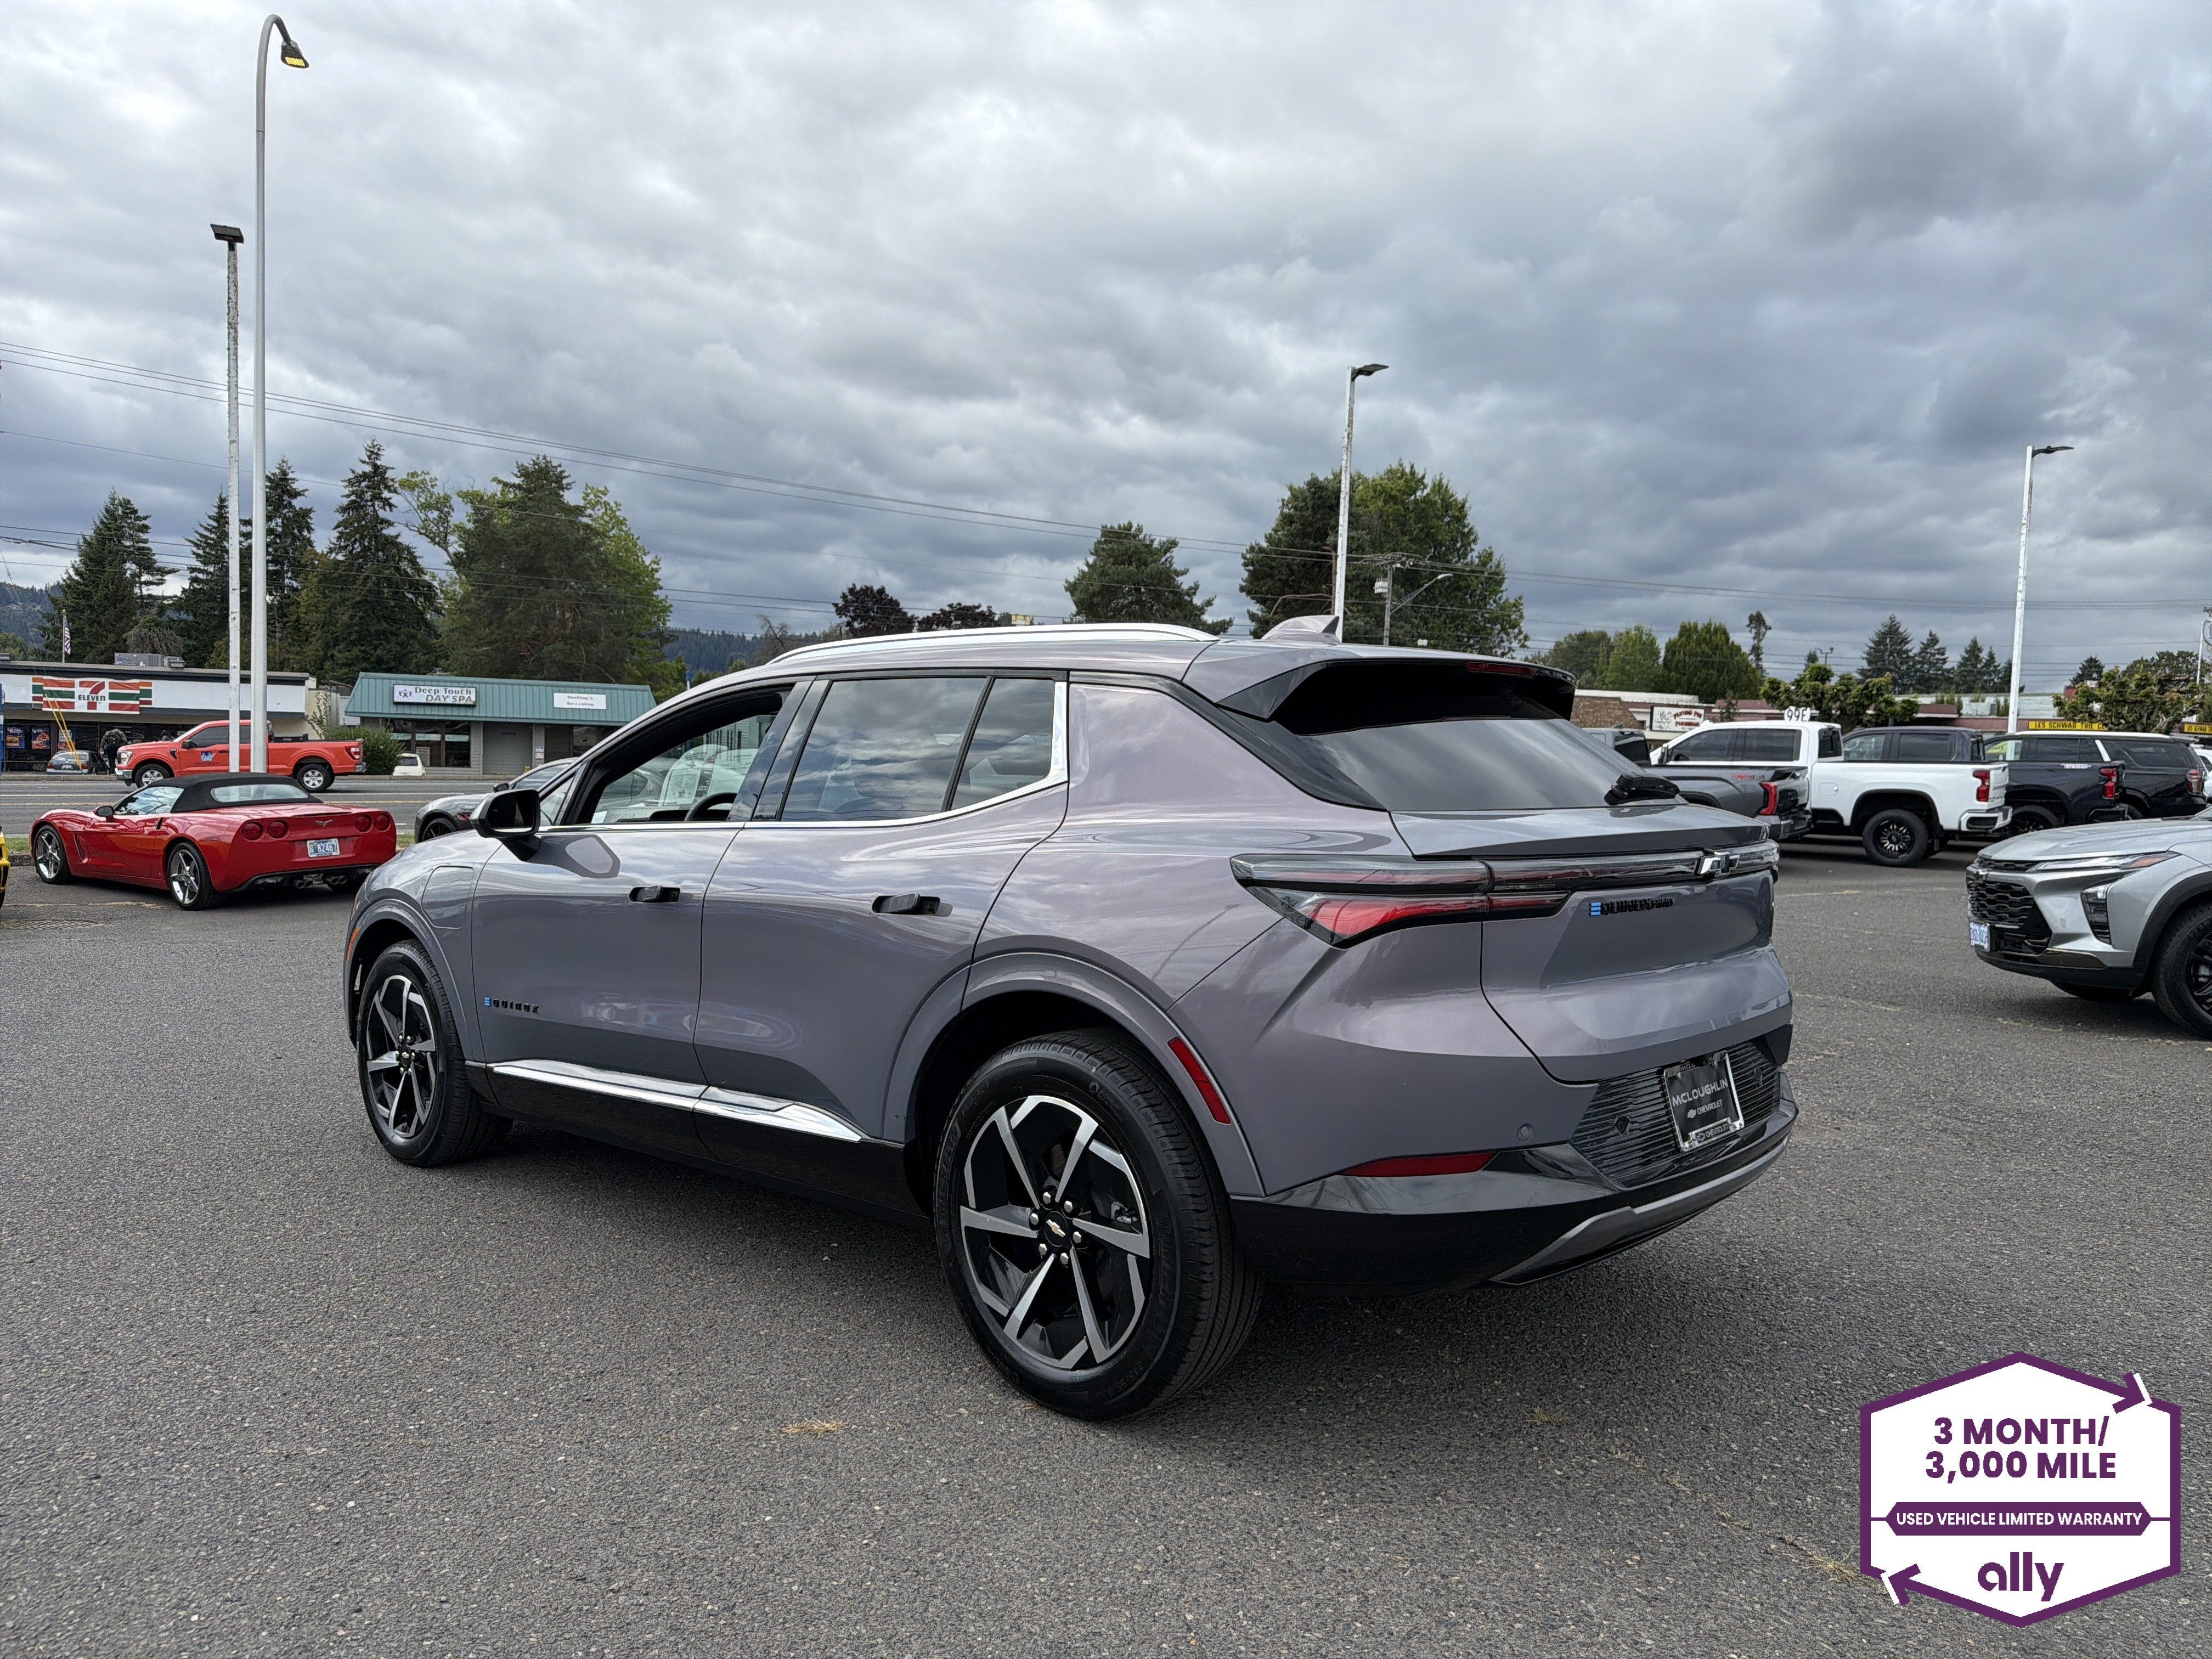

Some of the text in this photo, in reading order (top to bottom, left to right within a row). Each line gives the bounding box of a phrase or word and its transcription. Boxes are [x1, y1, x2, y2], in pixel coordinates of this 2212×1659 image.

[415, 686, 439, 696] Deep
[426, 694, 450, 702] DAY
[1787, 708, 1808, 721] 99E
[1672, 1077, 1729, 1107] MCLOUGHLIN
[1697, 1099, 1723, 1115] CHEVROLET
